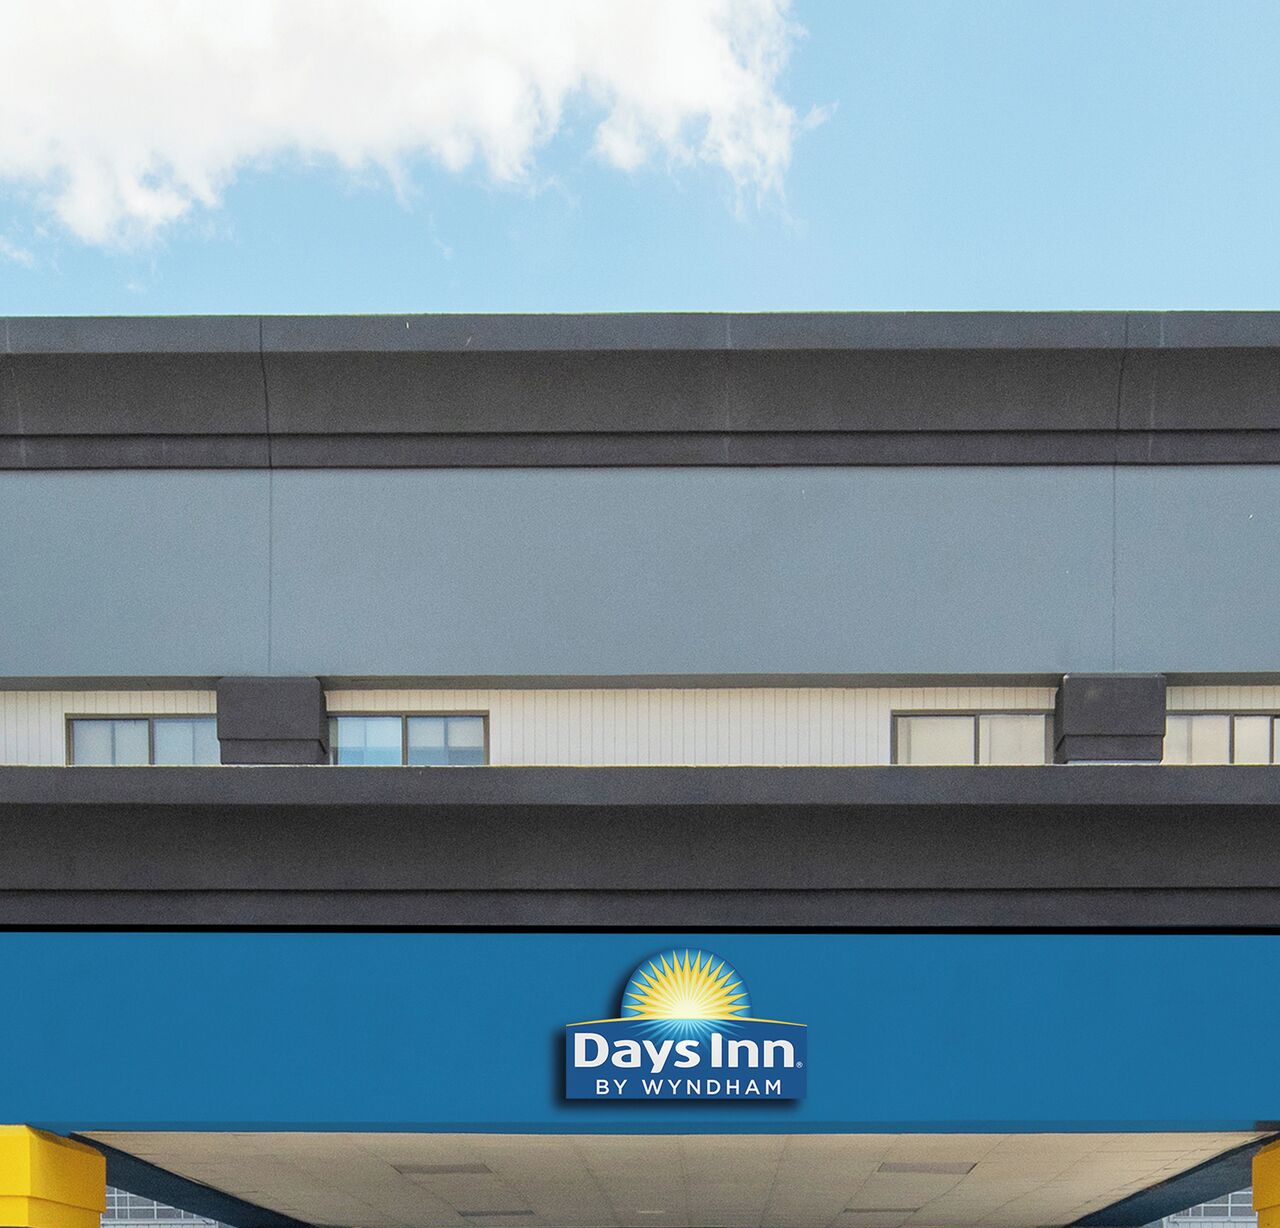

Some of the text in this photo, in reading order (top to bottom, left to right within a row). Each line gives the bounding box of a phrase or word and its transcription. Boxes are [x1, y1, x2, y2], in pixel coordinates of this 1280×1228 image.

[574, 1032, 795, 1073] Days Inn
[596, 1079, 782, 1095] BY WYNDHAM
